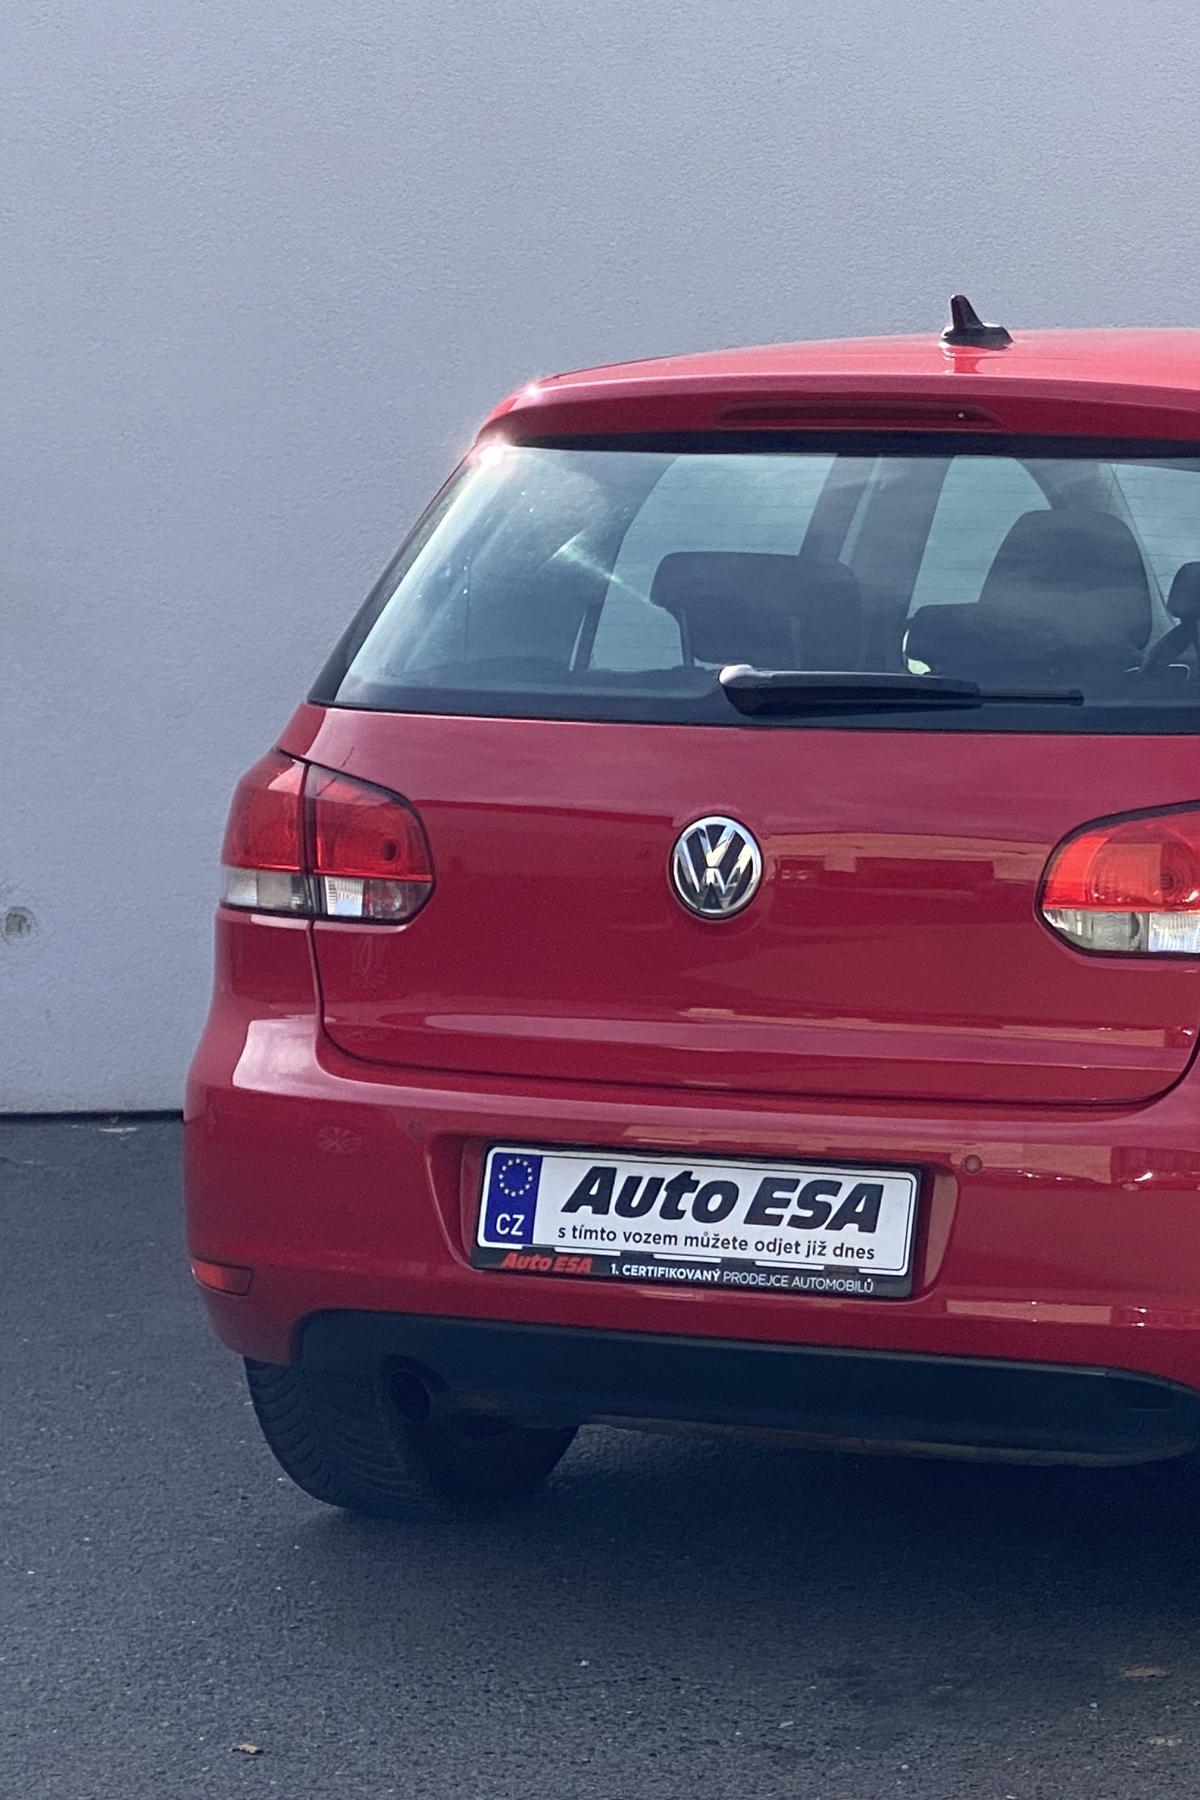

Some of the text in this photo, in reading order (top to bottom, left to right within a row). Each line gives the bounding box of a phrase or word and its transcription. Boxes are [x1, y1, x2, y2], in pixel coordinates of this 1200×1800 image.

[674, 816, 761, 914] VW
[561, 1166, 884, 1233] Auto ESA
[495, 1213, 525, 1236] CZ
[558, 1224, 875, 1260] s tímto vozem můžete odjet již dnes
[500, 1251, 593, 1273] Auto ESA
[611, 1264, 874, 1293] 1. CERTIFIKOVANÝ PRODEJCE AUTOMOBILŮ
